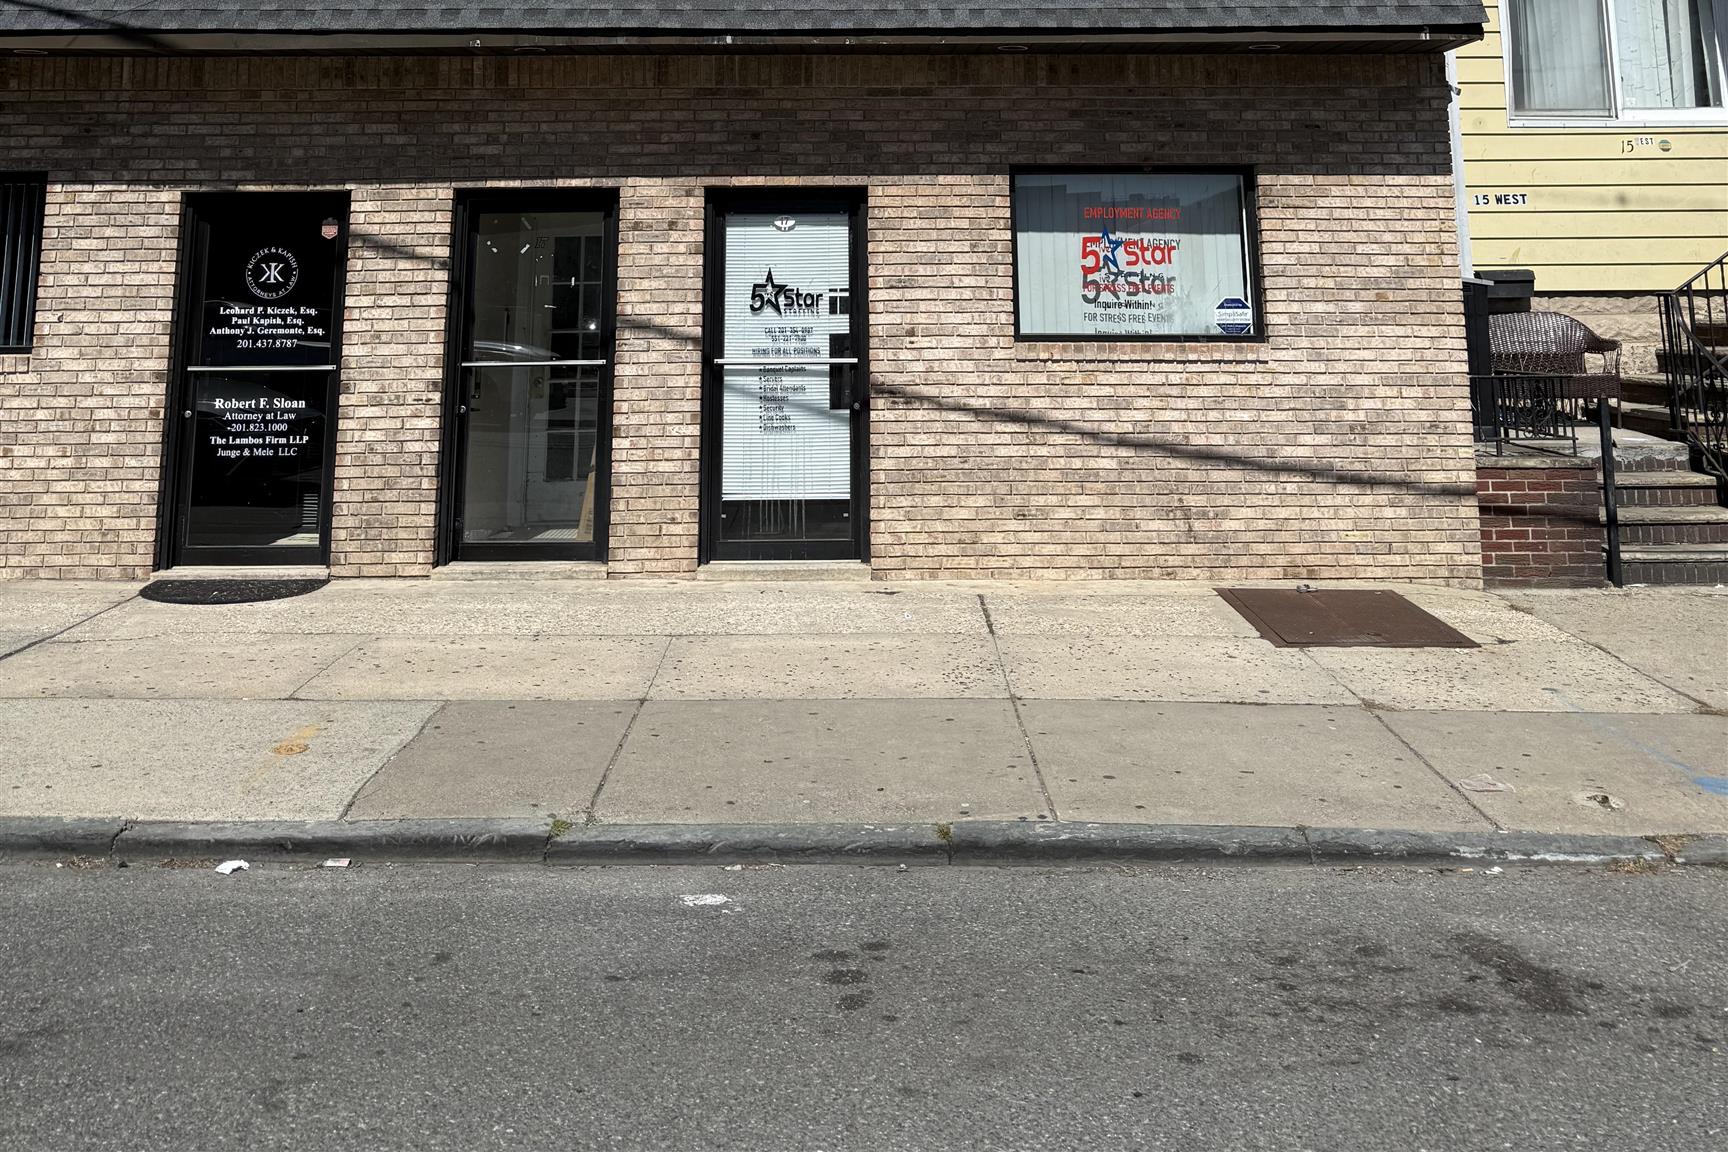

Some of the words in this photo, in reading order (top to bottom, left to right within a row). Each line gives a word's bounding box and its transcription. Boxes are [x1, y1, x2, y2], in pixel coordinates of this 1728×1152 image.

[1621, 140, 1634, 154] 15
[1474, 194, 1490, 206] 15
[1494, 193, 1528, 206] WEST
[1084, 208, 1144, 219] EMPLOYMENT
[1146, 208, 1181, 220] AGENCY
[781, 216, 791, 226] 17
[246, 247, 270, 269] KICZEK
[278, 247, 299, 268] KAPISH
[1081, 236, 1102, 274] 5
[1123, 239, 1177, 266] Star
[247, 276, 277, 298] ATTORNEYS
[286, 276, 296, 289] LAW
[749, 283, 768, 312] 5
[783, 287, 823, 308] Star
[1094, 299, 1122, 311] Inquire
[1124, 299, 1153, 310] Within!
[257, 307, 265, 315] P.
[300, 307, 318, 317] Esq.
[232, 316, 250, 324] Paul
[252, 316, 285, 326] Kapish,
[287, 316, 305, 326] Esq.
[210, 327, 246, 336] Anthony
[257, 327, 305, 335] Geremonte,
[307, 327, 326, 336] Esq.
[237, 339, 298, 348] 201.437.8787
[215, 397, 256, 409] Robert
[260, 398, 270, 408] F.
[273, 397, 306, 409] Sloan
[223, 412, 263, 421] Attorney
[265, 412, 274, 420] at
[277, 411, 297, 420] Law
[231, 423, 288, 432] 201.823.1000
[209, 436, 227, 444] The
[229, 436, 263, 444] Lambos
[265, 436, 287, 444] Firm
[289, 435, 309, 444] LLP
[217, 448, 241, 459] Junge
[242, 448, 251, 456] &
[253, 448, 274, 456] Mele
[278, 448, 298, 456] LLC
